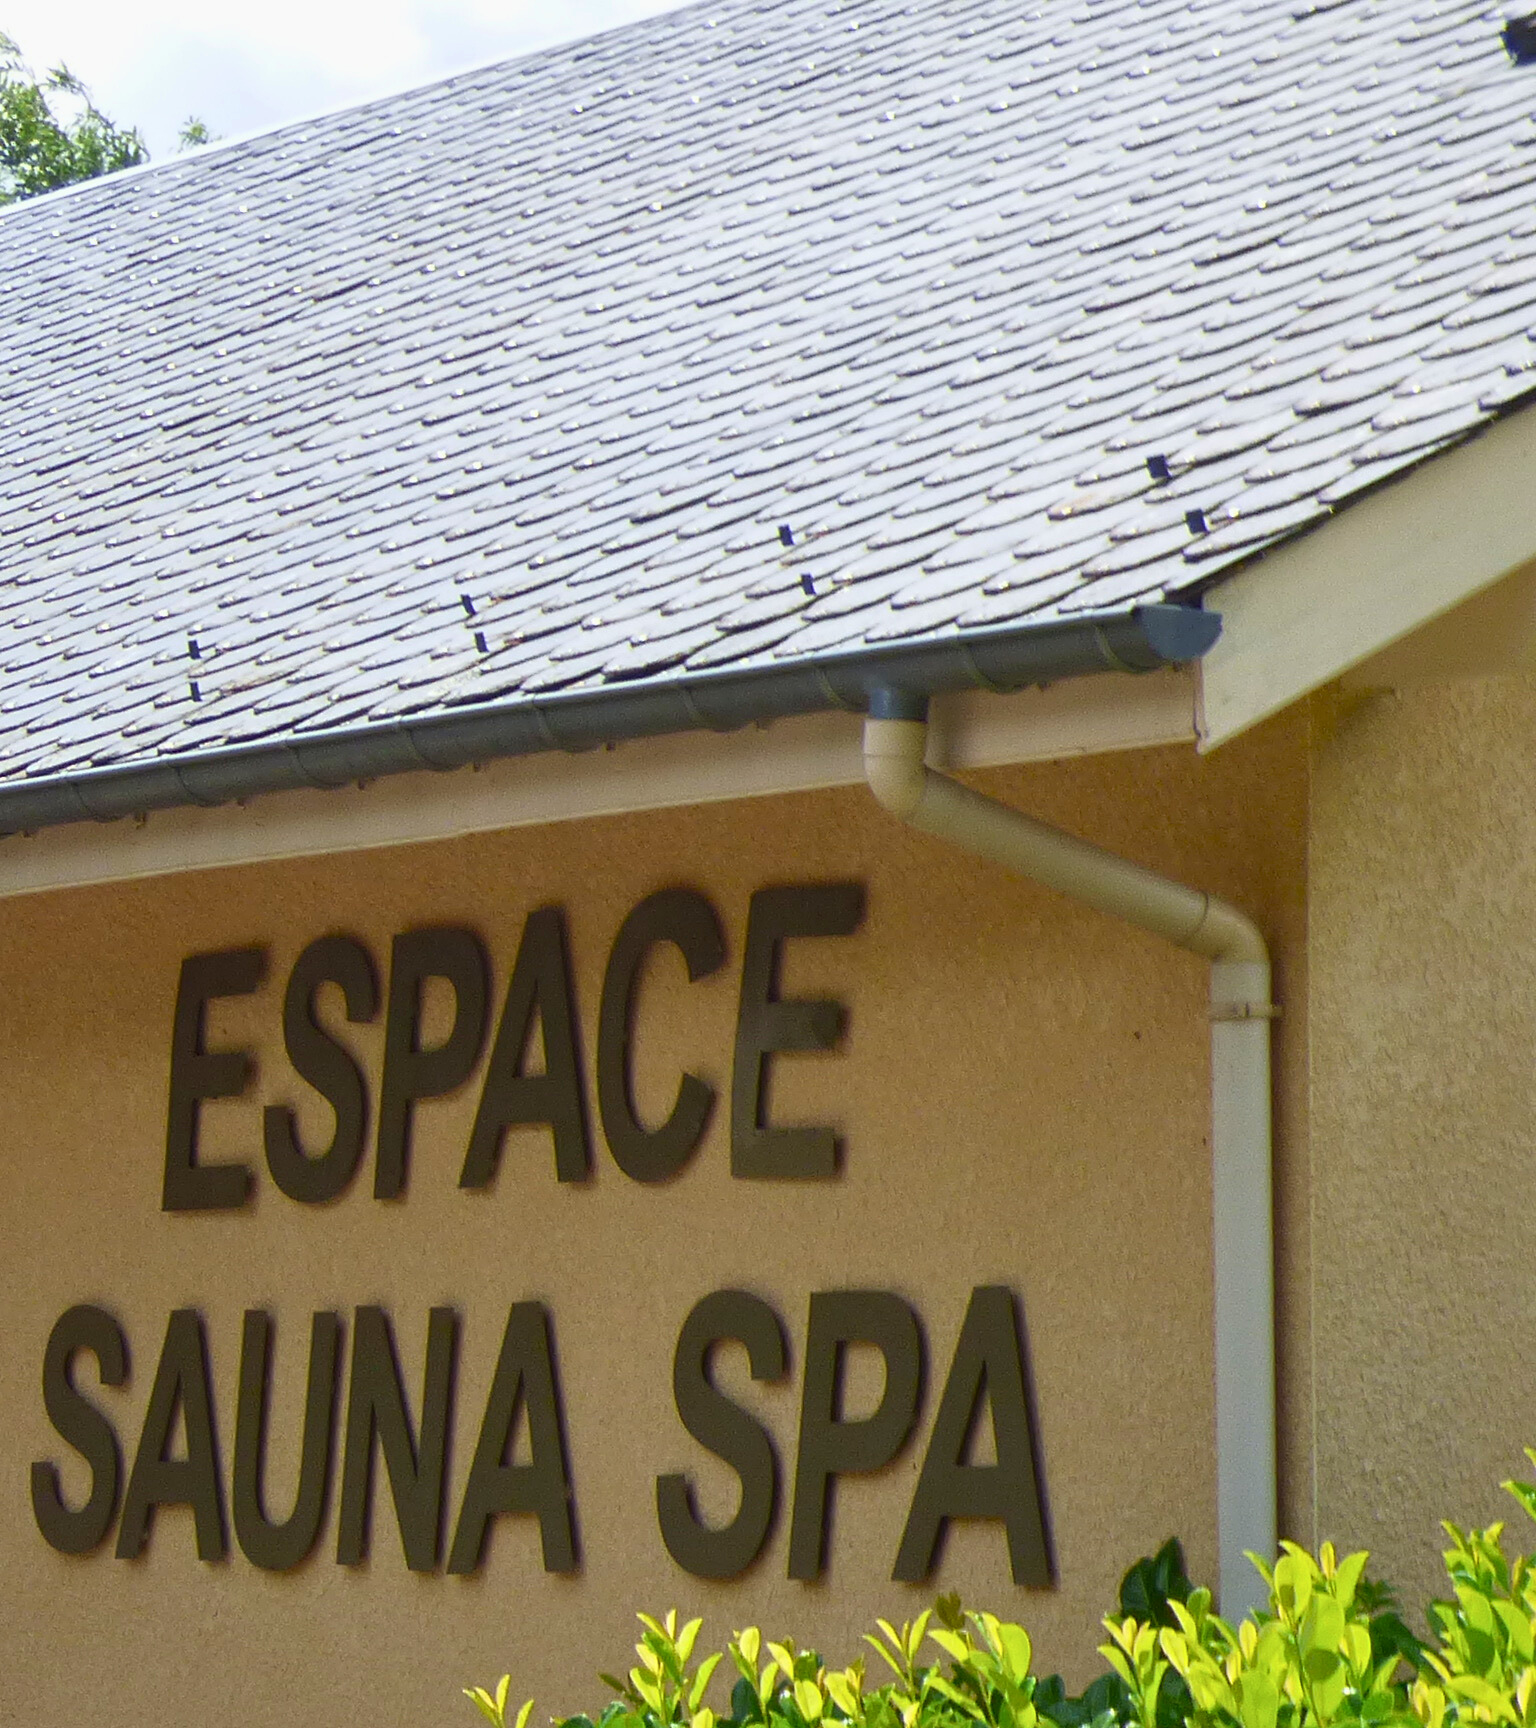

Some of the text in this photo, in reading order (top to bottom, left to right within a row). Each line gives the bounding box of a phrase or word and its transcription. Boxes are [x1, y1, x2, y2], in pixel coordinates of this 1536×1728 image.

[162, 880, 868, 1212] ESPACE
[30, 1285, 1058, 1588] SAUNA SPA
